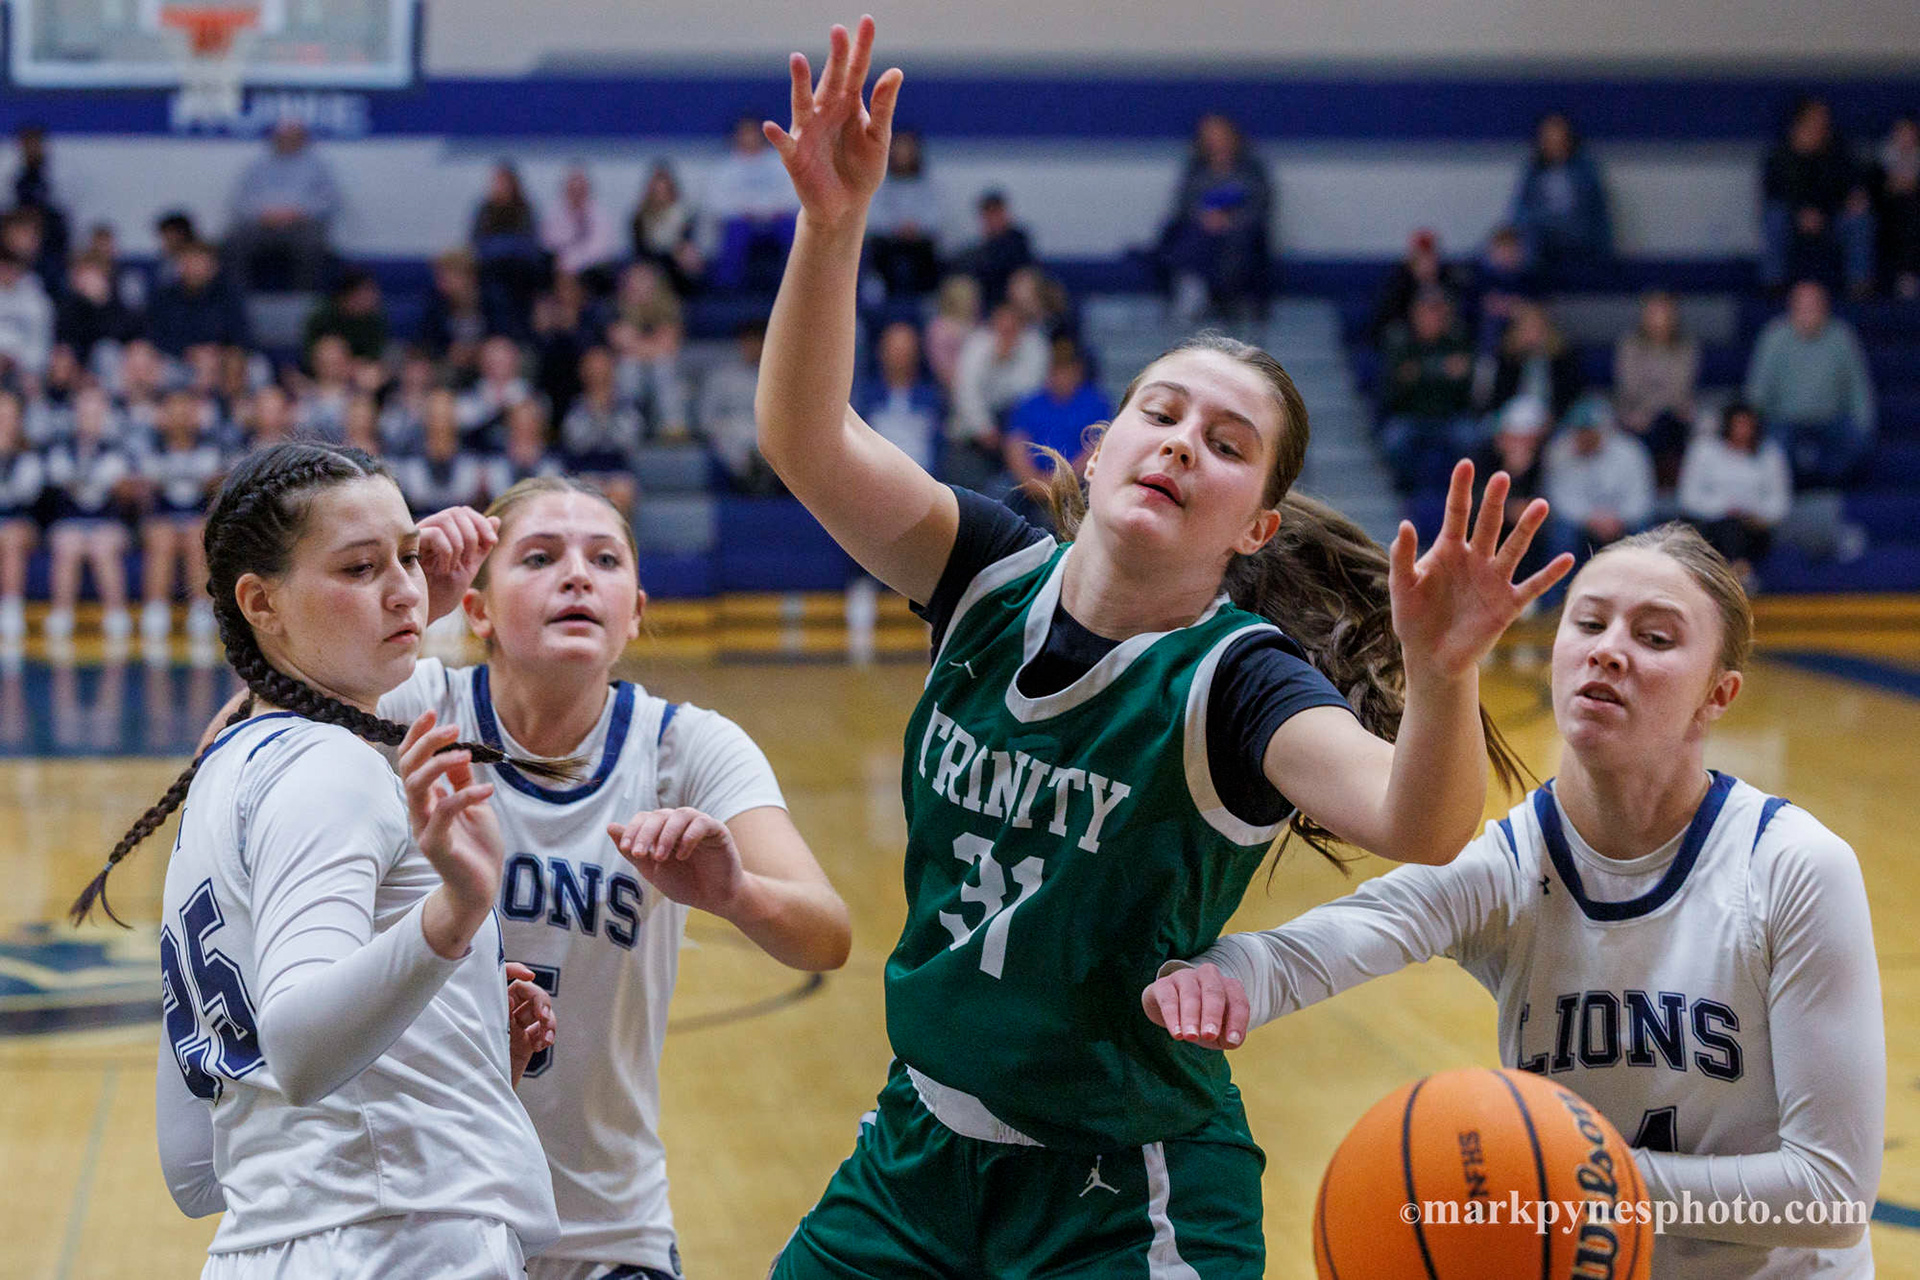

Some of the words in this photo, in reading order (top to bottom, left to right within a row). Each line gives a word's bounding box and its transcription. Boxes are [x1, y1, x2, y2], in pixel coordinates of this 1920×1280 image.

[919, 702, 1132, 854] TRINITY
[500, 852, 644, 951] ONS
[939, 831, 1045, 980] 31
